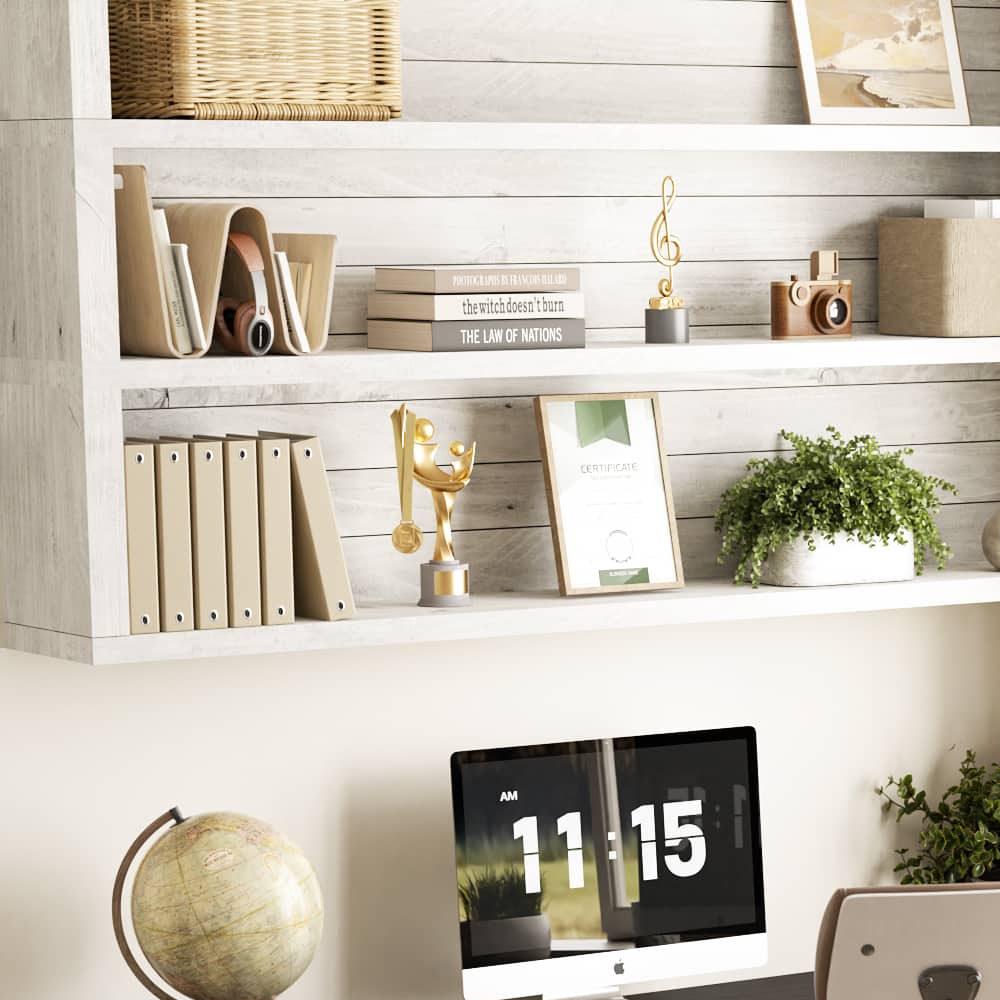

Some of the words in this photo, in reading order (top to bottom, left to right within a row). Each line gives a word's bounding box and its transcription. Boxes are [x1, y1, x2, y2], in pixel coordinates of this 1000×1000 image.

[462, 298, 479, 315] the
[480, 297, 505, 314] witch
[506, 296, 542, 313] doesn't
[542, 296, 565, 312] burn
[460, 329, 481, 344] THE
[483, 328, 503, 344] LAW
[505, 328, 519, 343] OF
[521, 327, 563, 343] NATIONS
[580, 462, 639, 474] CERTIFICATE
[500, 790, 518, 802] AM
[512, 799, 707, 895] 11:15
